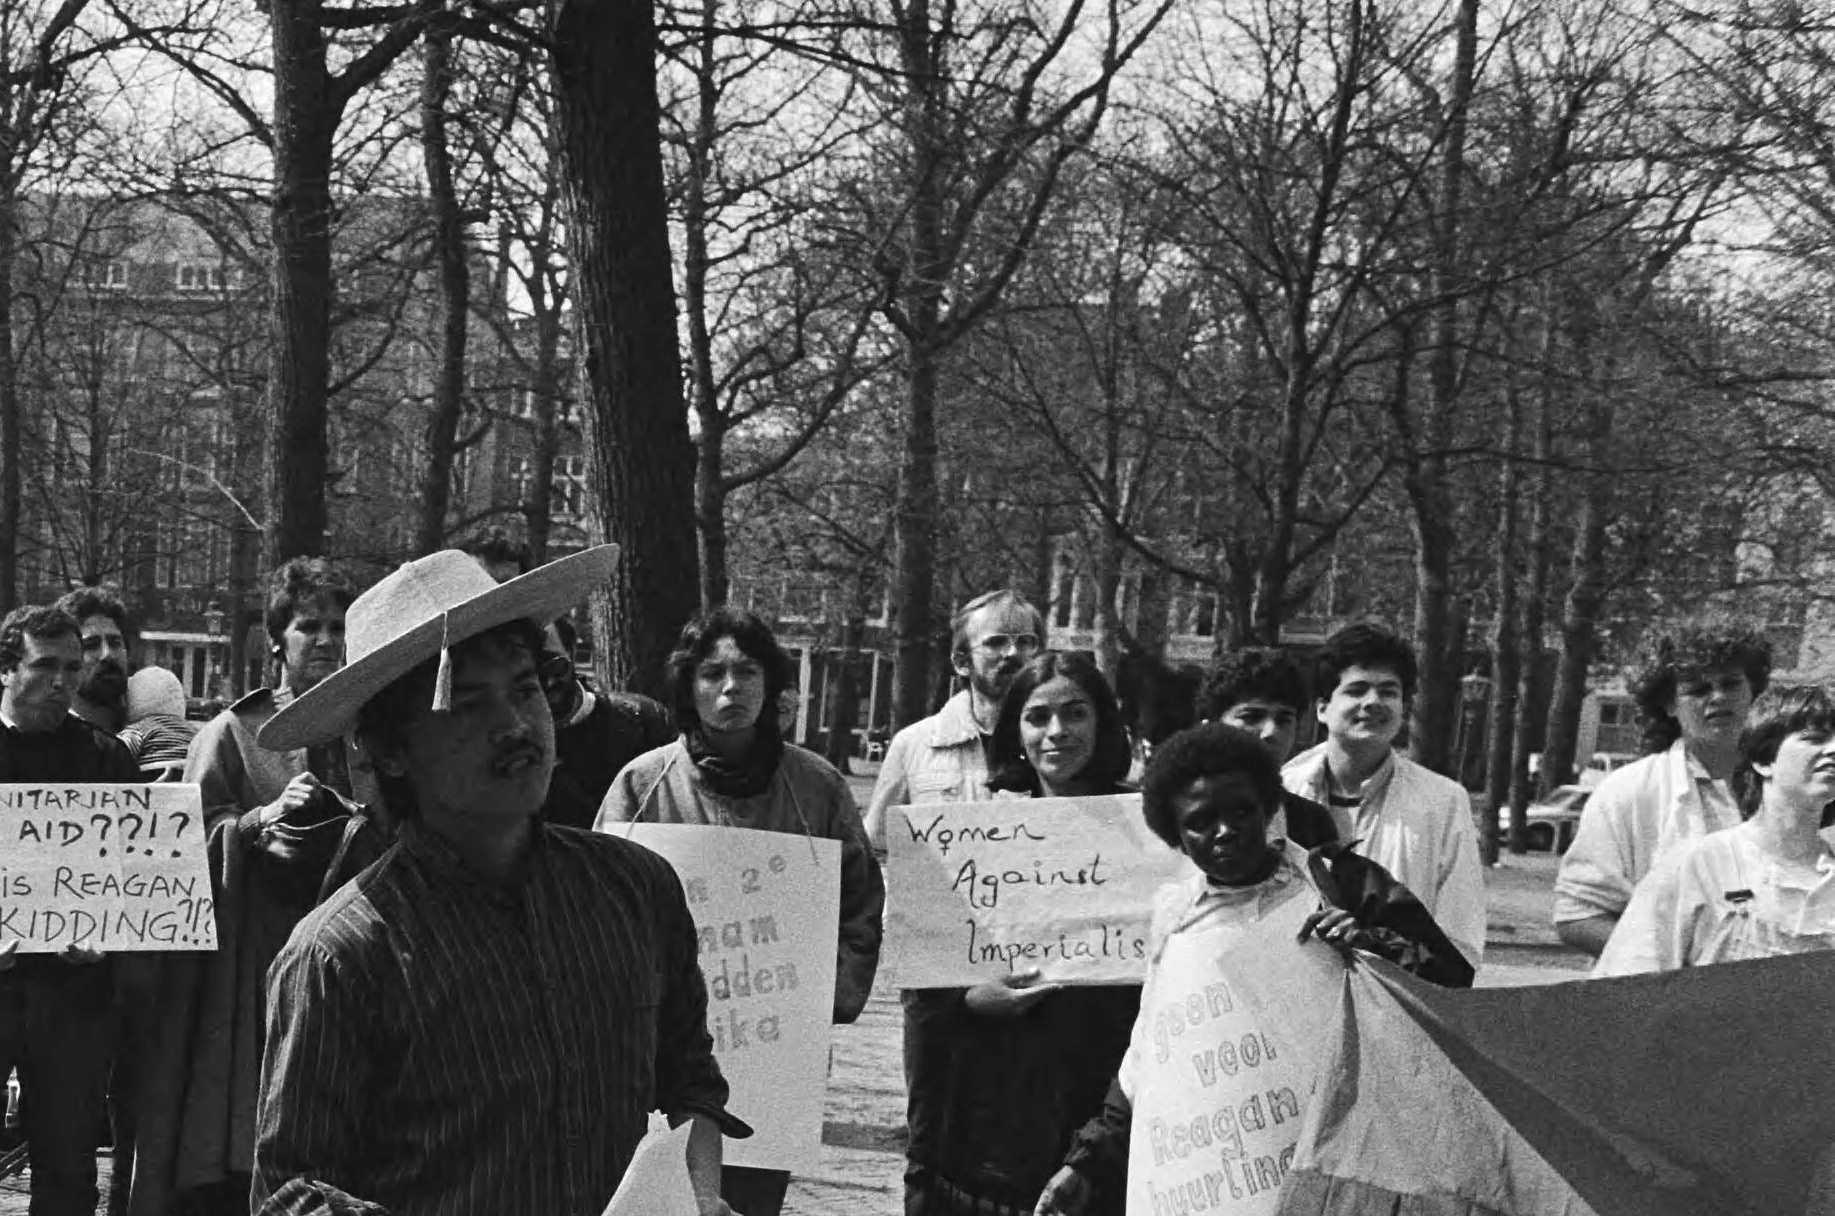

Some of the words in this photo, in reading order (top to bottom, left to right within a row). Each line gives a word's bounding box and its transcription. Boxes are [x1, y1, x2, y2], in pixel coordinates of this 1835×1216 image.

[18, 811, 191, 859] AID??!?
[902, 814, 1046, 857] Women
[53, 865, 197, 900] REAGAN
[952, 853, 1109, 909] Against
